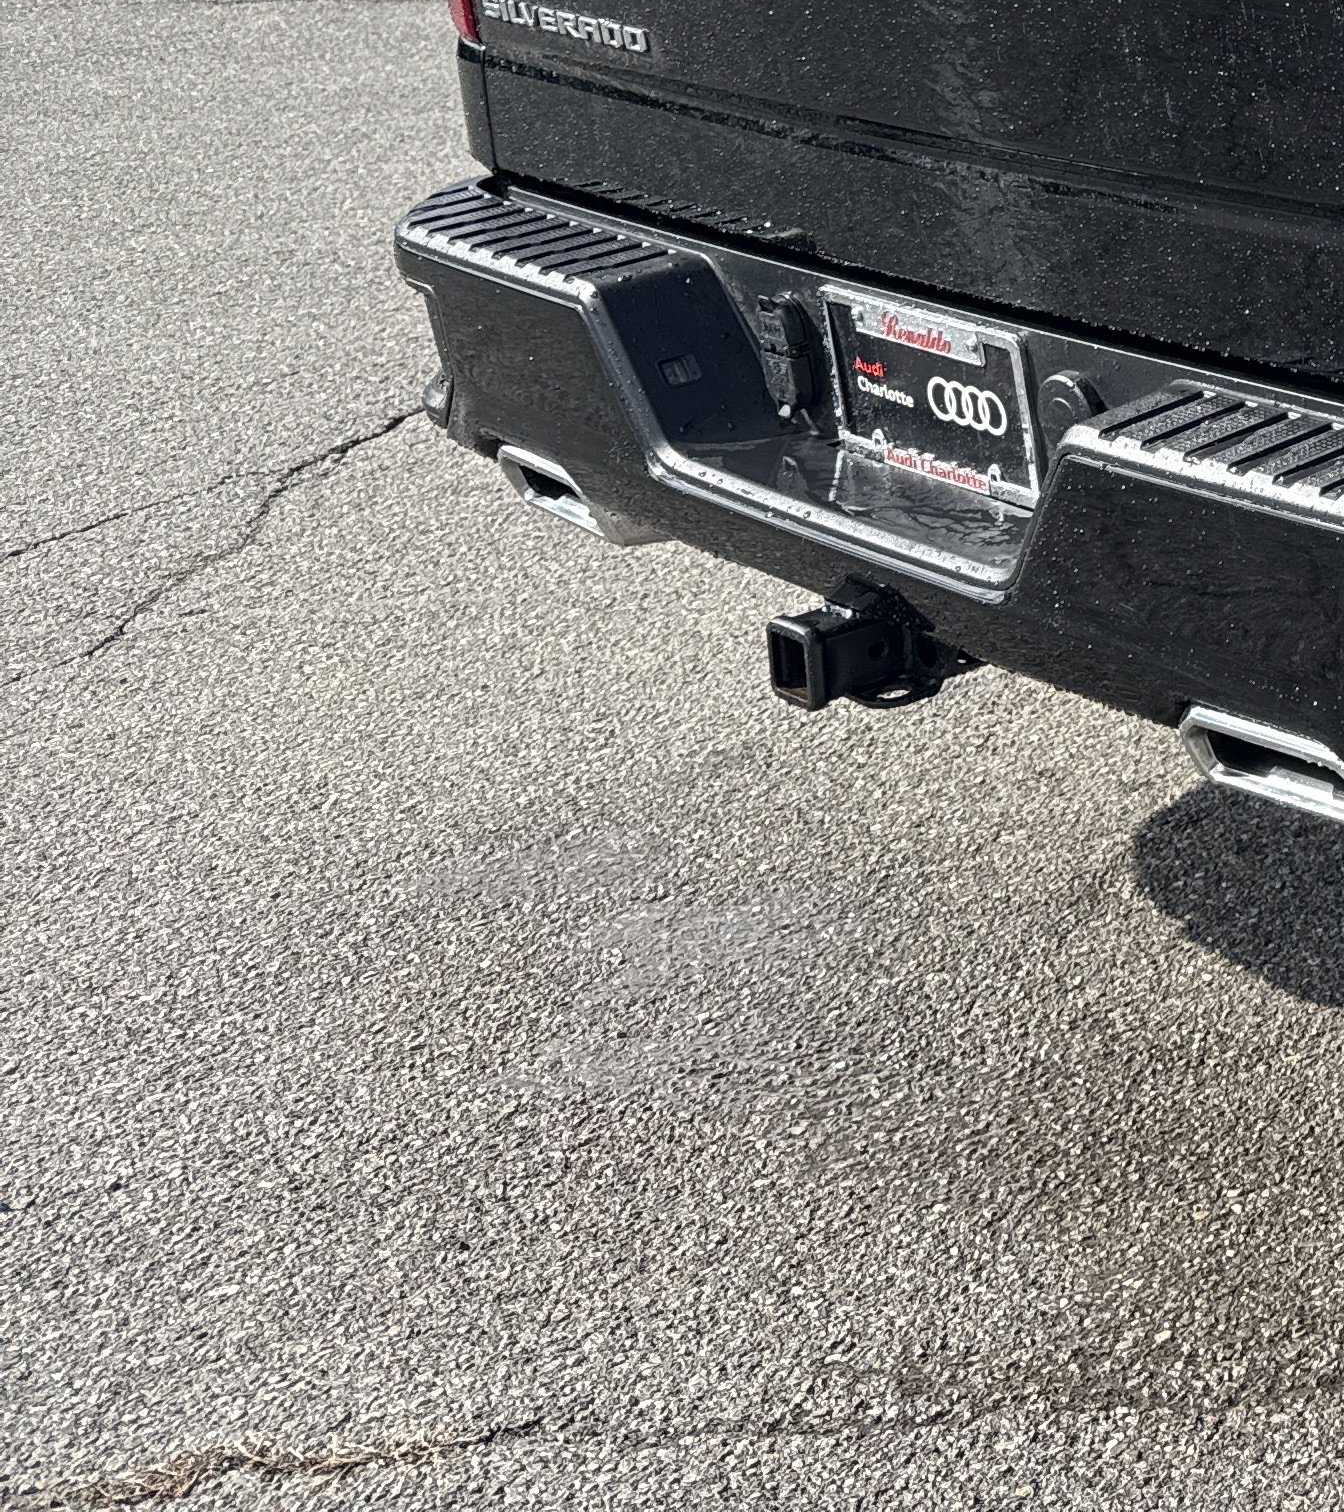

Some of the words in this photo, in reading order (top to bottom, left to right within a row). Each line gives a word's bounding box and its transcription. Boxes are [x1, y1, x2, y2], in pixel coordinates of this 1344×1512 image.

[853, 355, 886, 377] Audi
[857, 376, 915, 408] Charlotte
[886, 446, 918, 470] Audi
[920, 455, 988, 490] Charlotte
